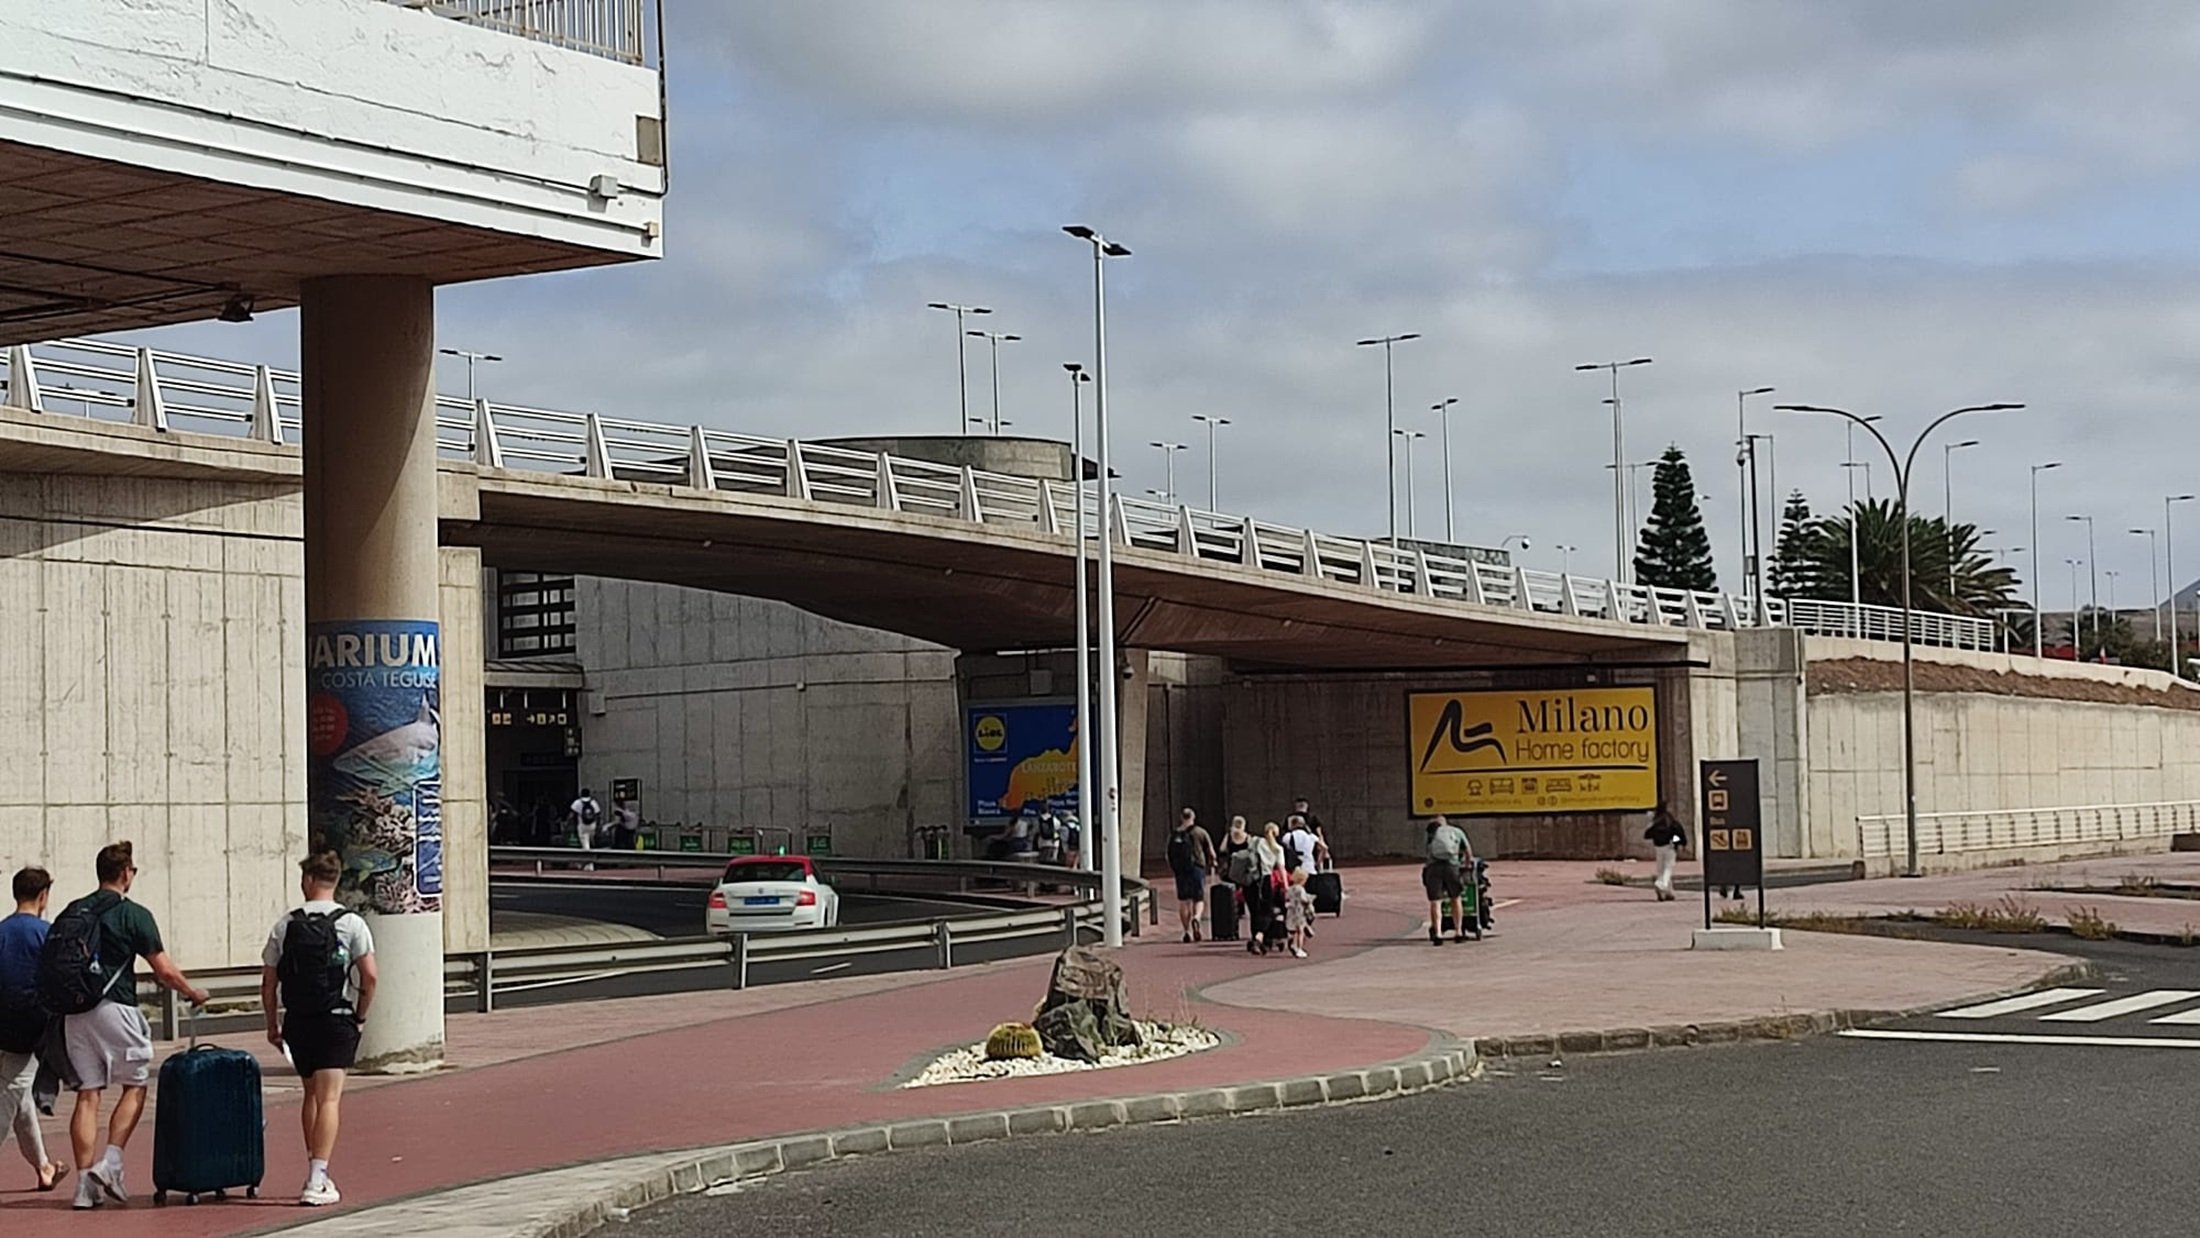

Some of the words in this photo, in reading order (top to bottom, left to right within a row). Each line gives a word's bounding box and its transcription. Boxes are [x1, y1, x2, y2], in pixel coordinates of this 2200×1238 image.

[308, 633, 437, 669] ARIUM
[322, 671, 375, 688] COSTA
[1516, 696, 1649, 734] Milano
[1516, 738, 1574, 761] Home
[1582, 737, 1649, 763] factory
